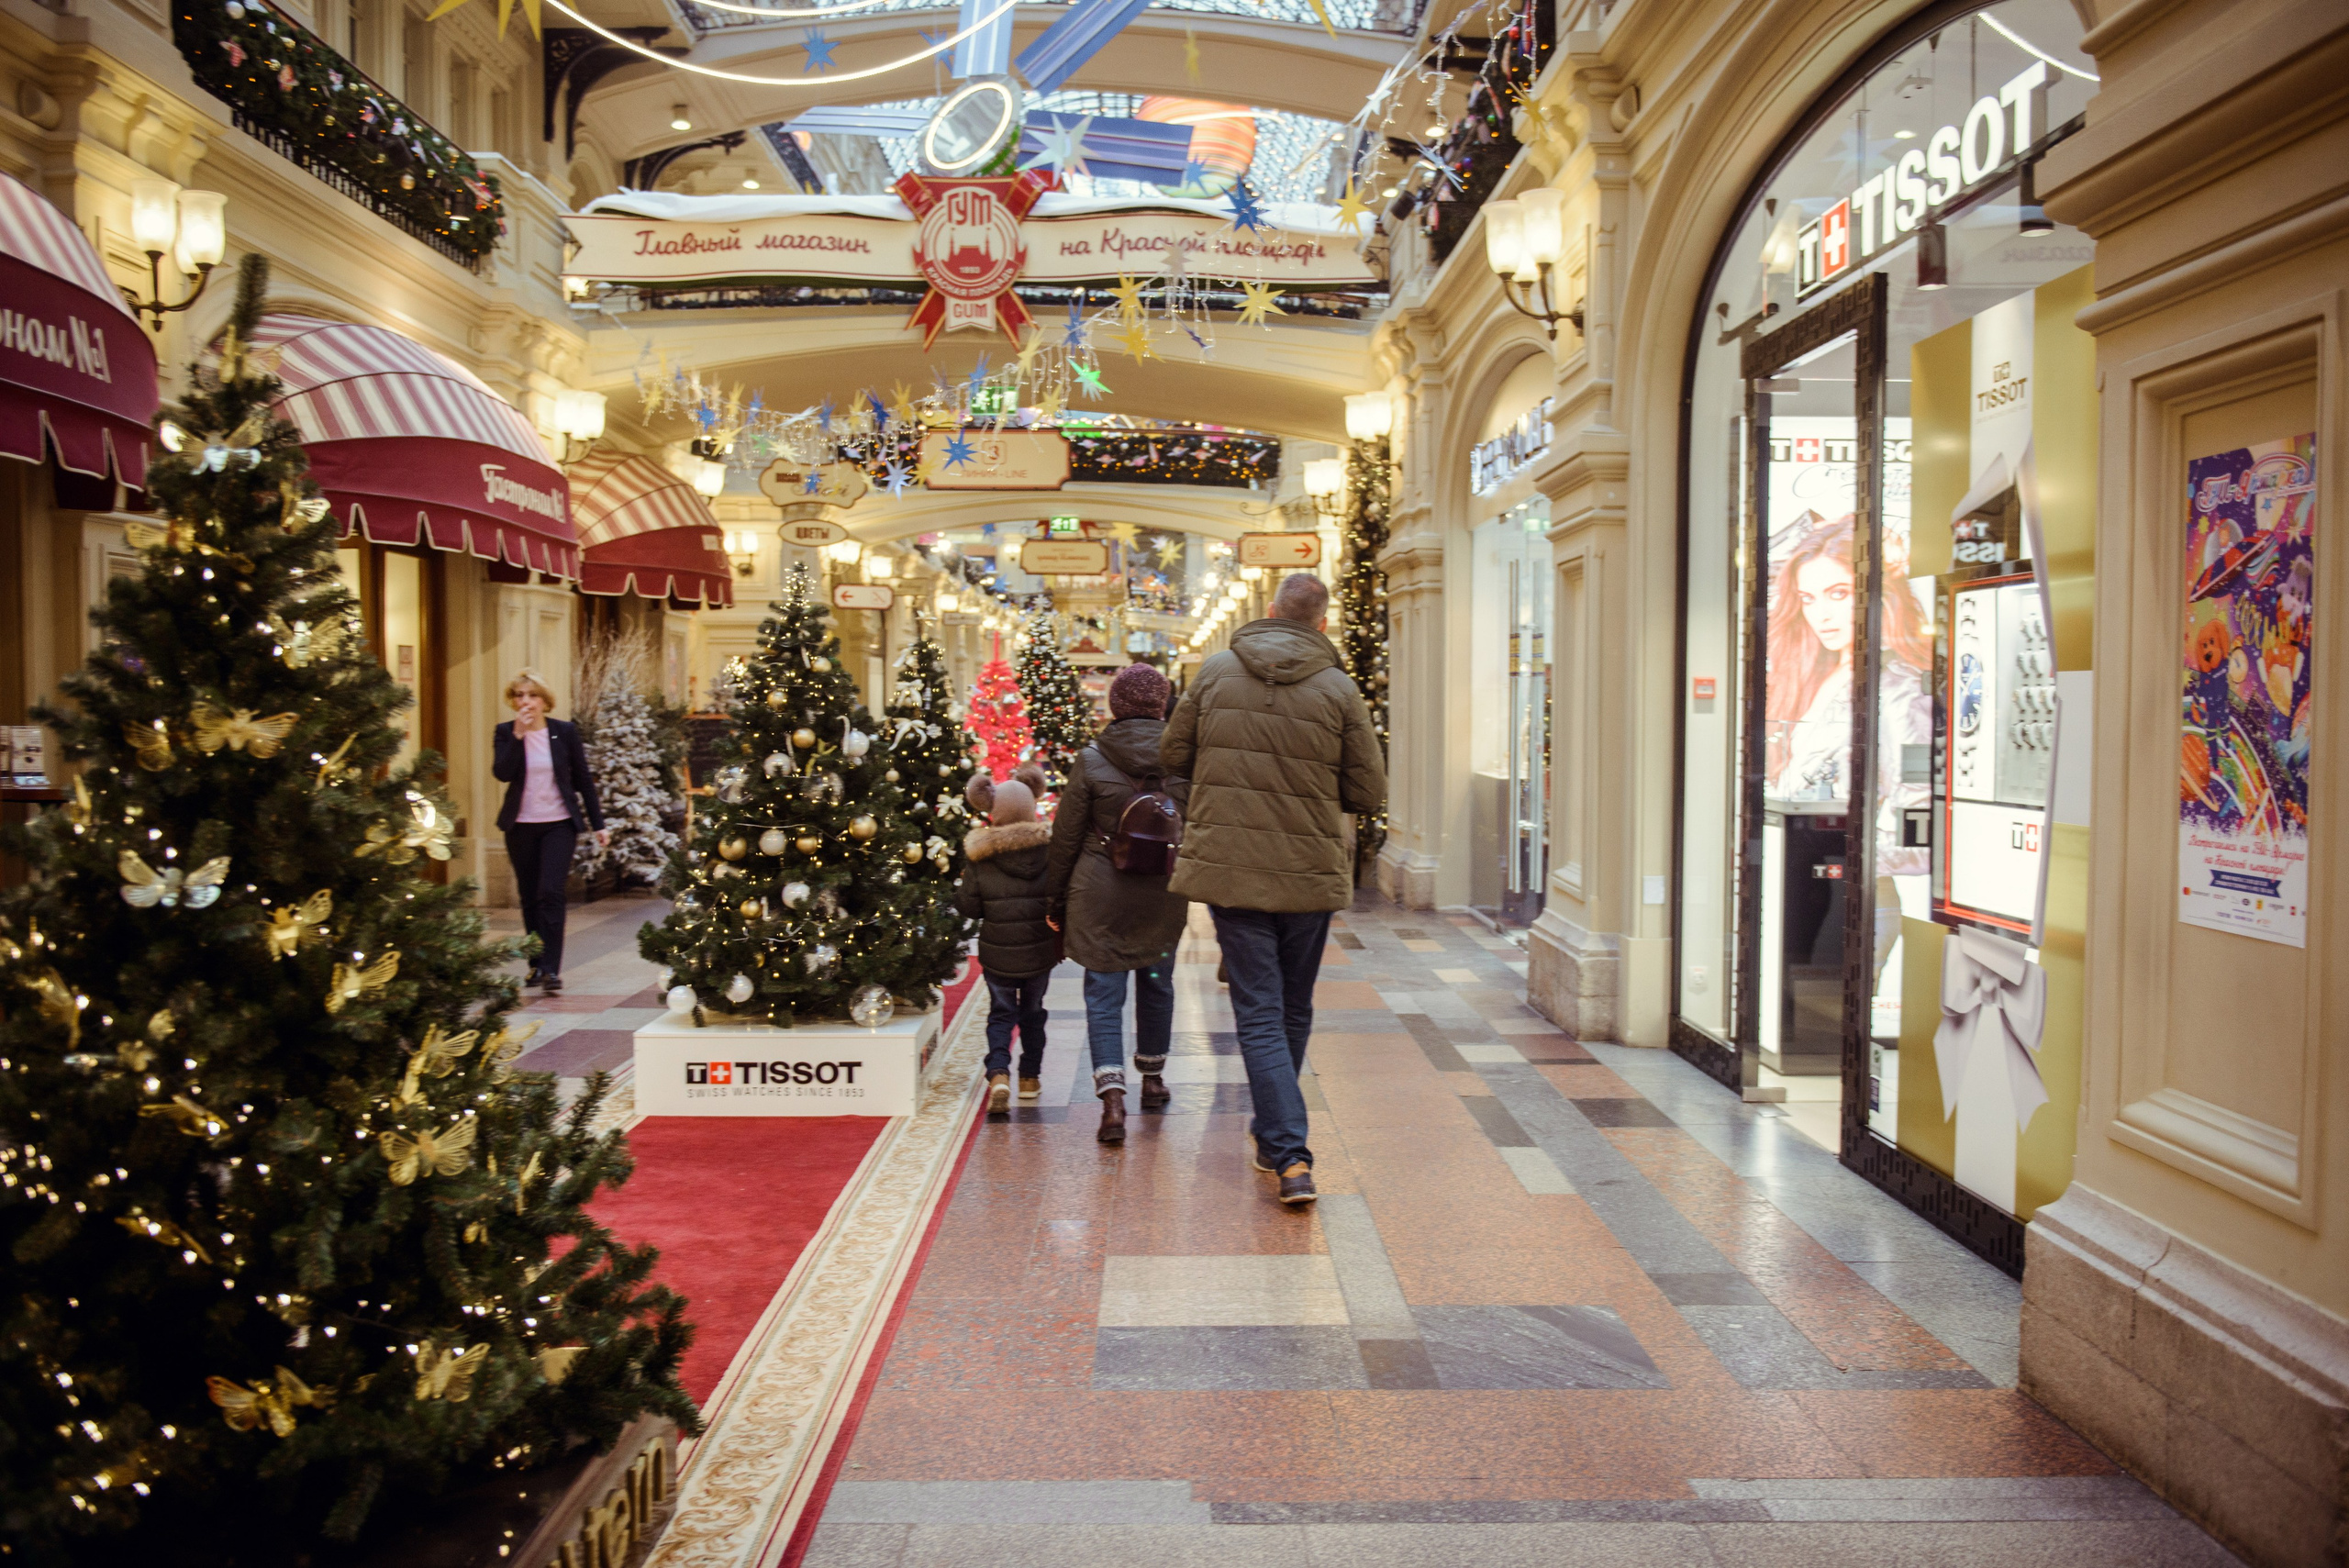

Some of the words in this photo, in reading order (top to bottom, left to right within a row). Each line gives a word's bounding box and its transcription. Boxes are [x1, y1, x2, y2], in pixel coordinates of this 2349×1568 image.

[1852, 61, 2046, 257] TISSOT
[948, 191, 991, 226] ГУМ
[633, 228, 741, 256] Главный
[755, 234, 872, 255] магазин
[1060, 239, 1092, 256] на
[953, 303, 988, 318] GUM
[0, 308, 73, 368] ном
[1976, 376, 2028, 412] TISSOT
[988, 445, 1000, 461] 3
[1006, 469, 1028, 478] LINE
[735, 1061, 863, 1084] TISSOT
[687, 1088, 728, 1098] SWISS
[732, 1087, 791, 1096] WATCHES
[796, 1087, 833, 1097] SINCE
[839, 1088, 865, 1098] 1853
